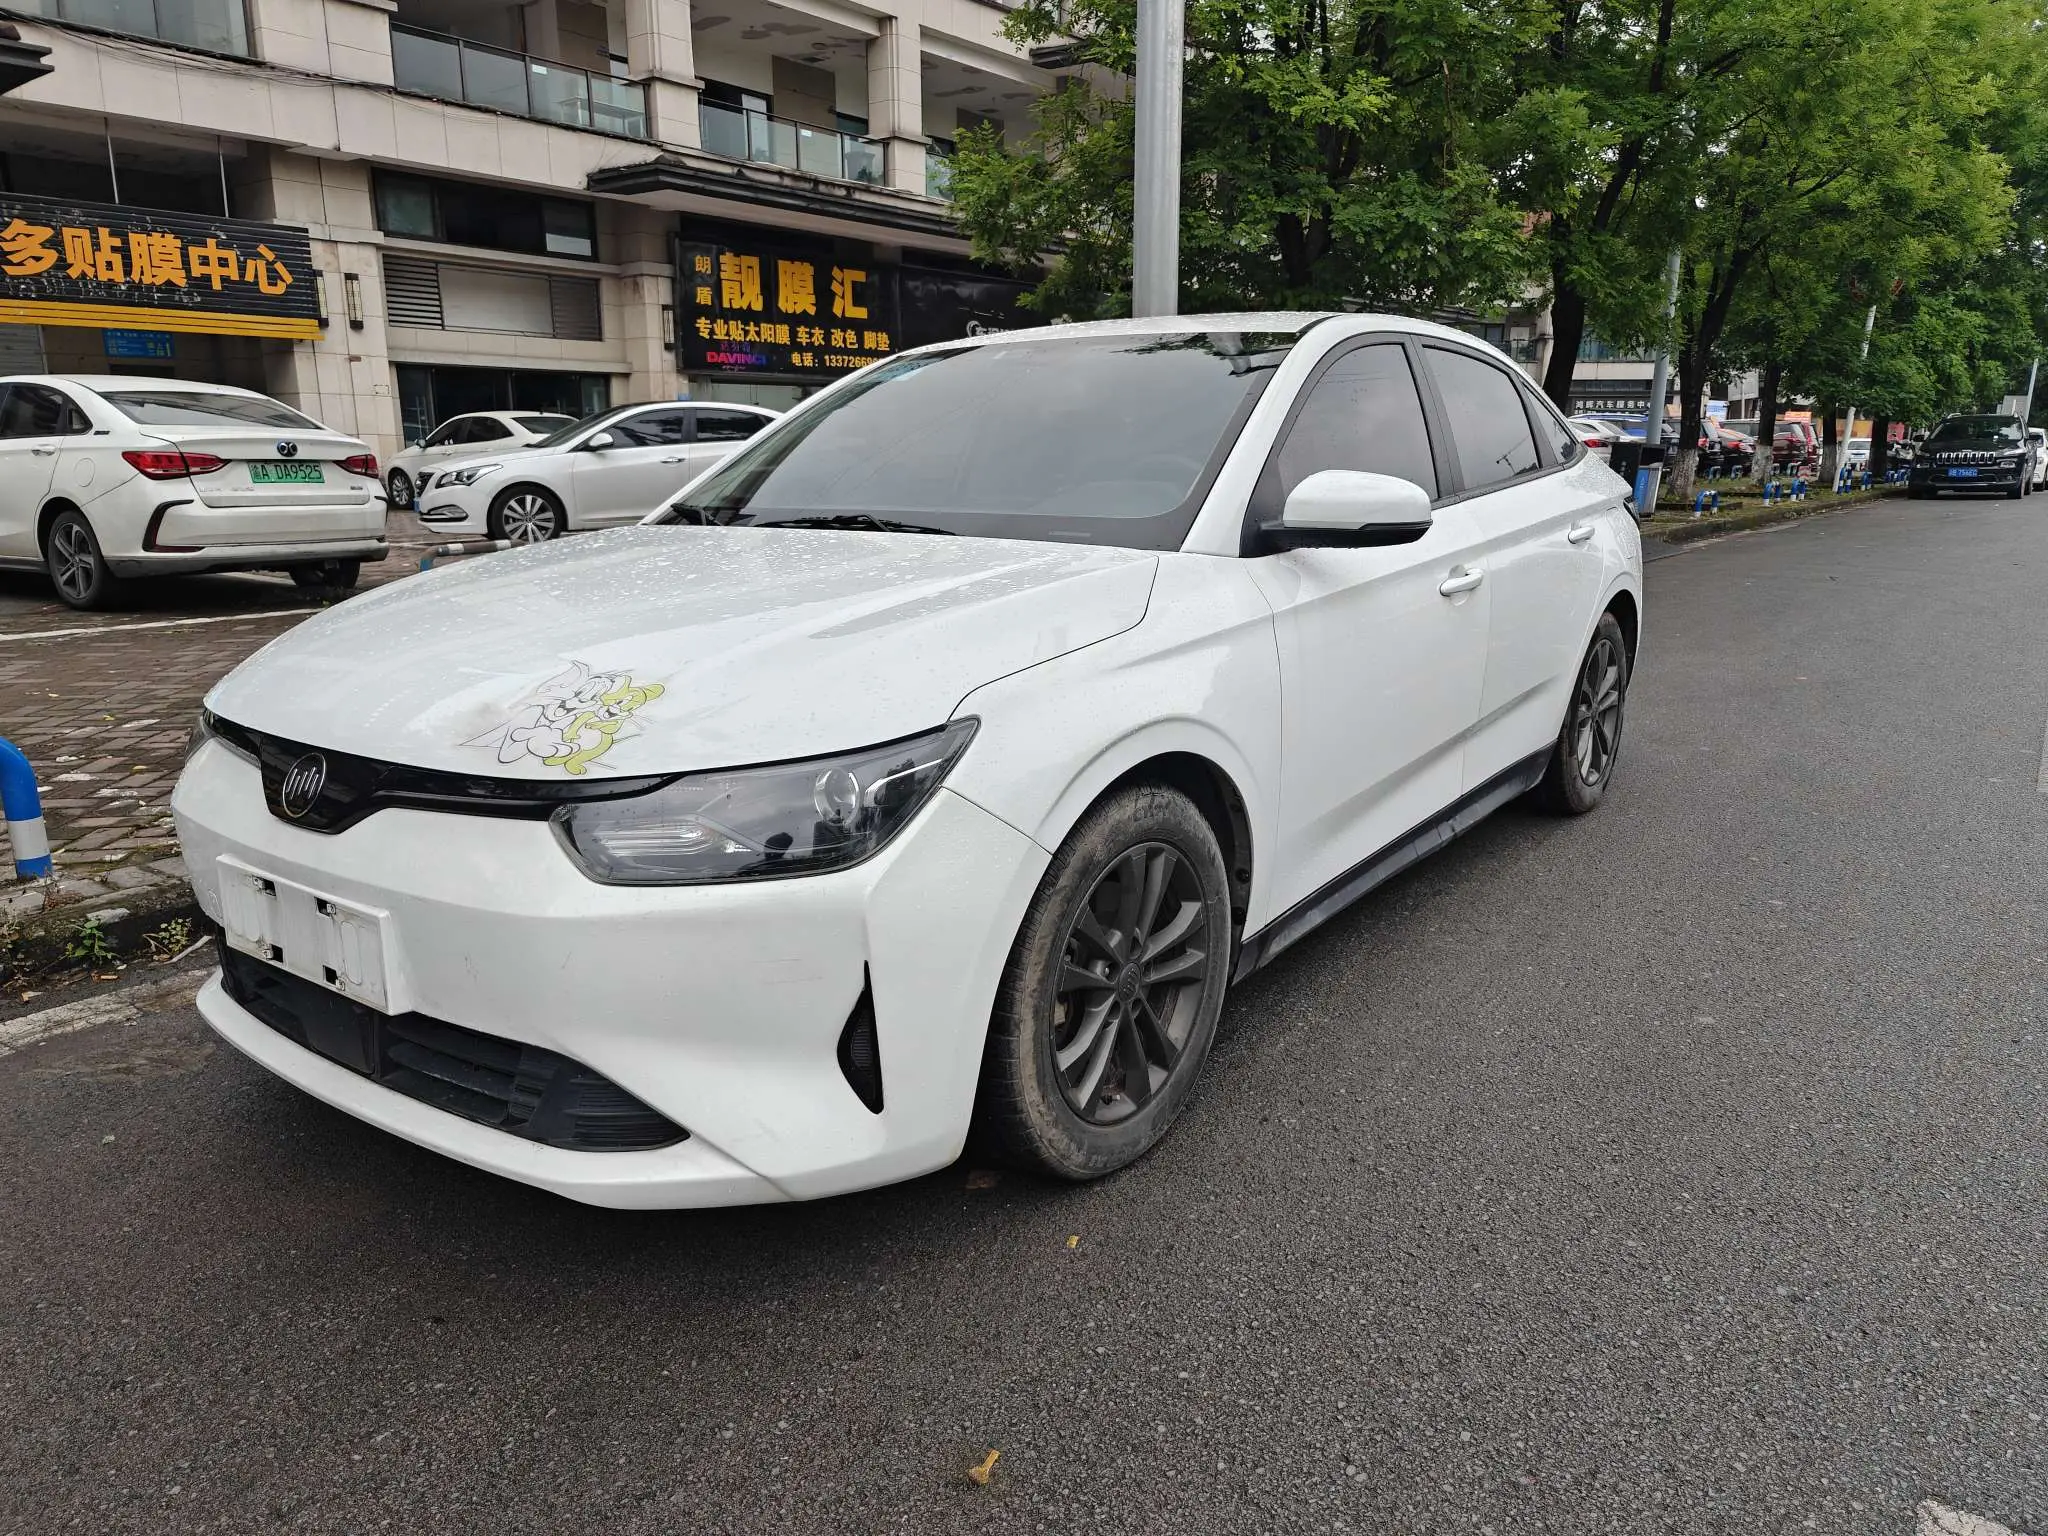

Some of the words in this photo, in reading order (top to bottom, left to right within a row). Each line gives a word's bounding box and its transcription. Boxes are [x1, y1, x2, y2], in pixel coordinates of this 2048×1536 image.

[0, 218, 293, 295] 多贴膜中心
[695, 255, 712, 306] 朗盾
[719, 251, 868, 320] 靓膜汇
[695, 316, 791, 346] 专业贴太阳膜
[796, 325, 825, 347] 车衣
[831, 328, 859, 350] 改色
[863, 330, 890, 351] 脚垫
